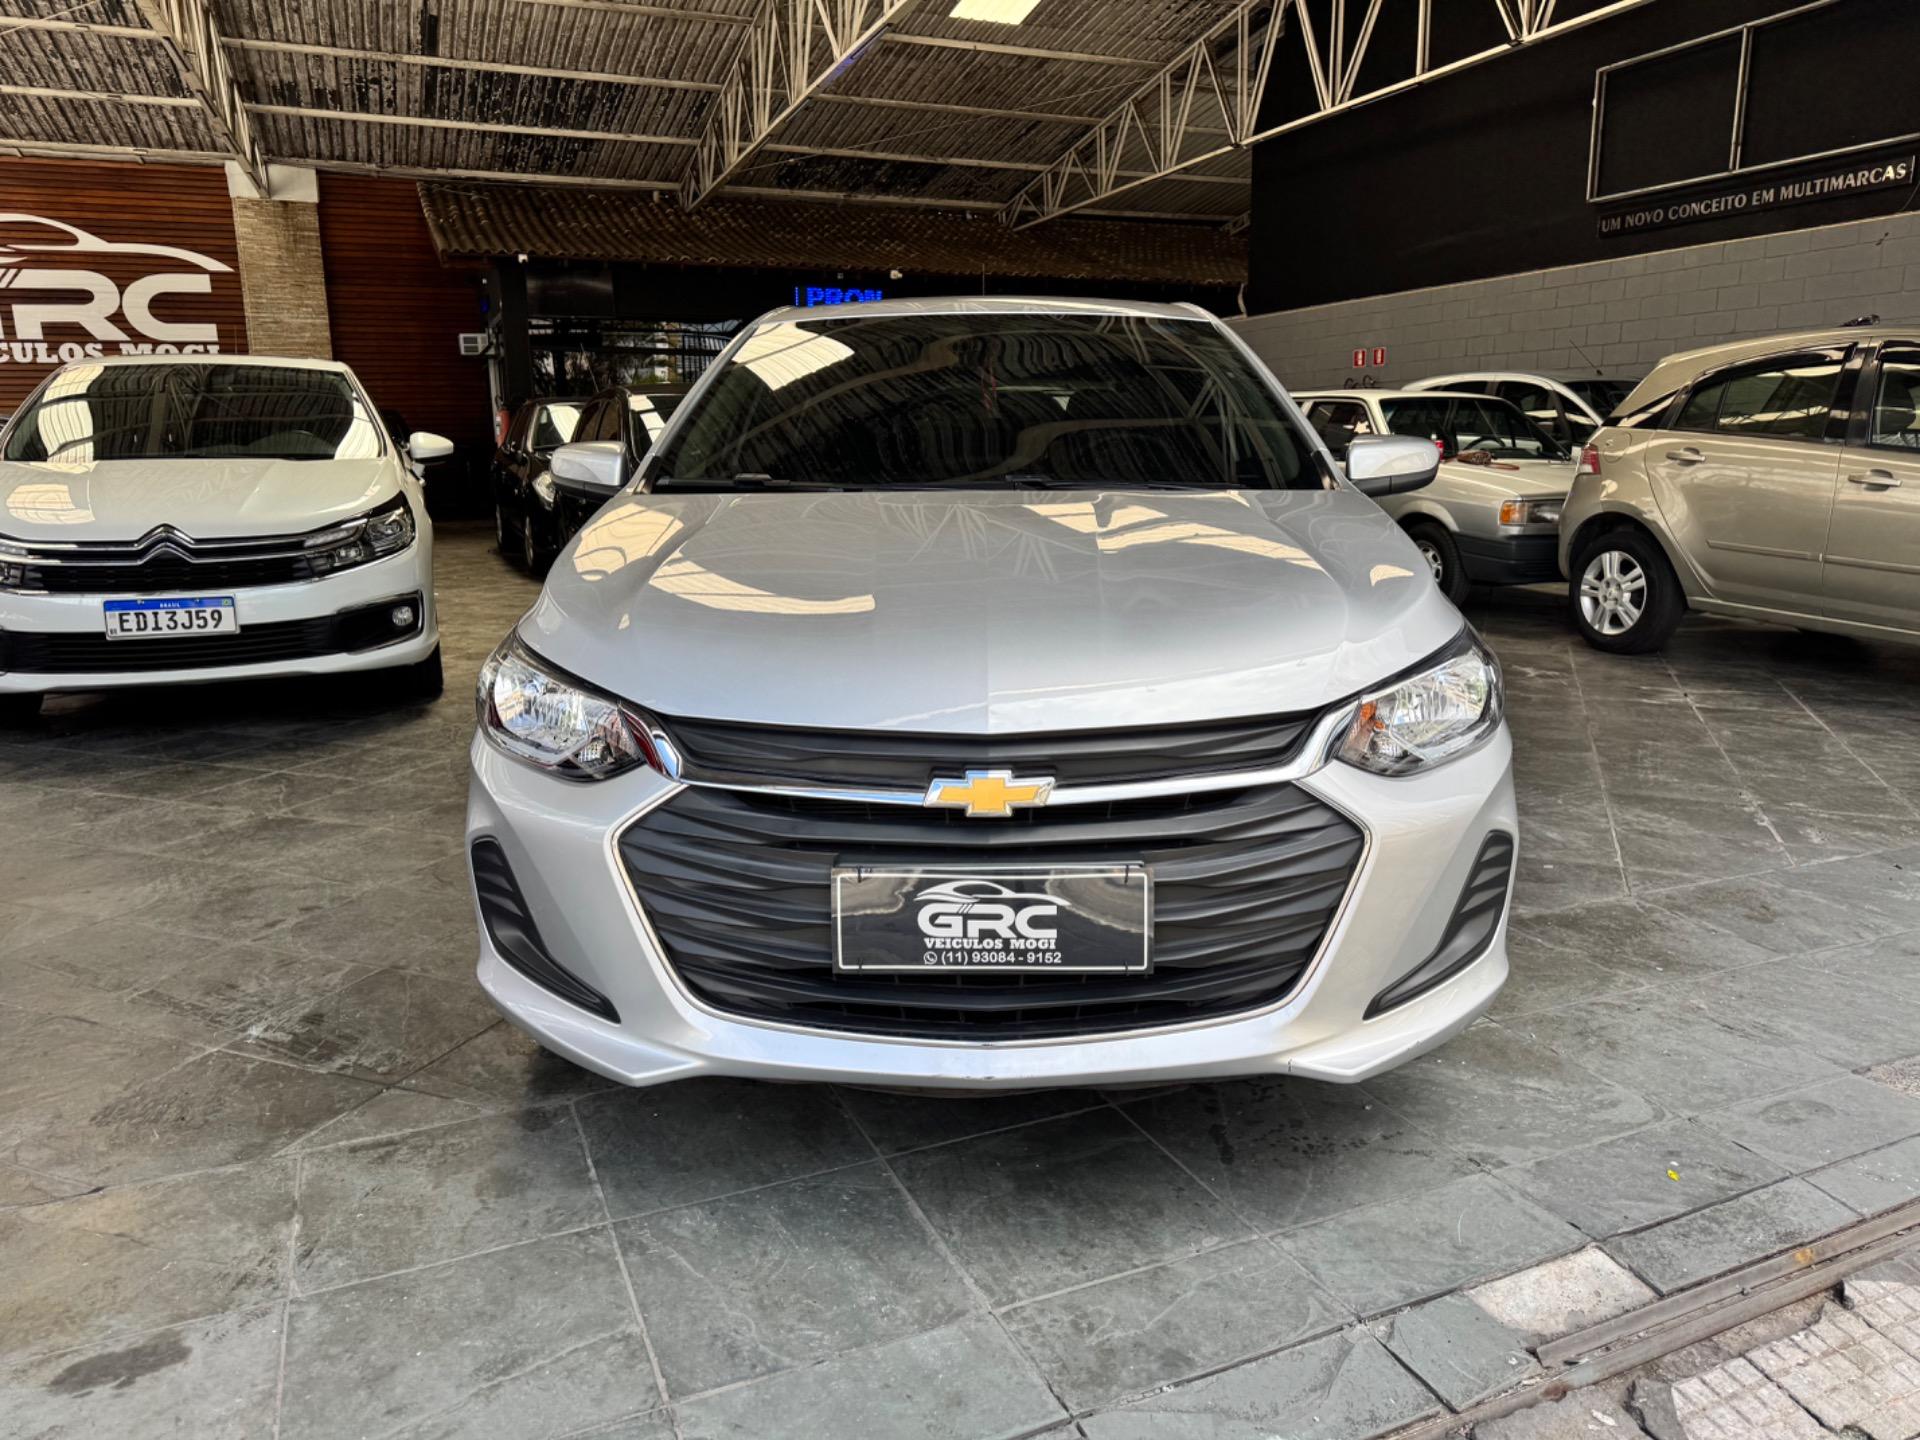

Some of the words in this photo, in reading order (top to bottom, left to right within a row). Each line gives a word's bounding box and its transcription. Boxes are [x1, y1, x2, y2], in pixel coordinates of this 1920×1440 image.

[1601, 214, 1621, 233] UM
[1624, 208, 1664, 229] NOVO
[1668, 193, 1748, 220] CONCEITO
[1752, 186, 1775, 206] EM
[1781, 163, 1906, 199] MULTIMARCAS
[0, 268, 219, 342] RC
[119, 610, 222, 632] EDI3J59
[917, 903, 1057, 937] GRC
[923, 937, 1004, 950] VEICULOS
[1009, 938, 1057, 950] MOGI
[941, 951, 969, 966] (11)
[971, 951, 1016, 964] 93084
[1026, 951, 1062, 964] 9152
